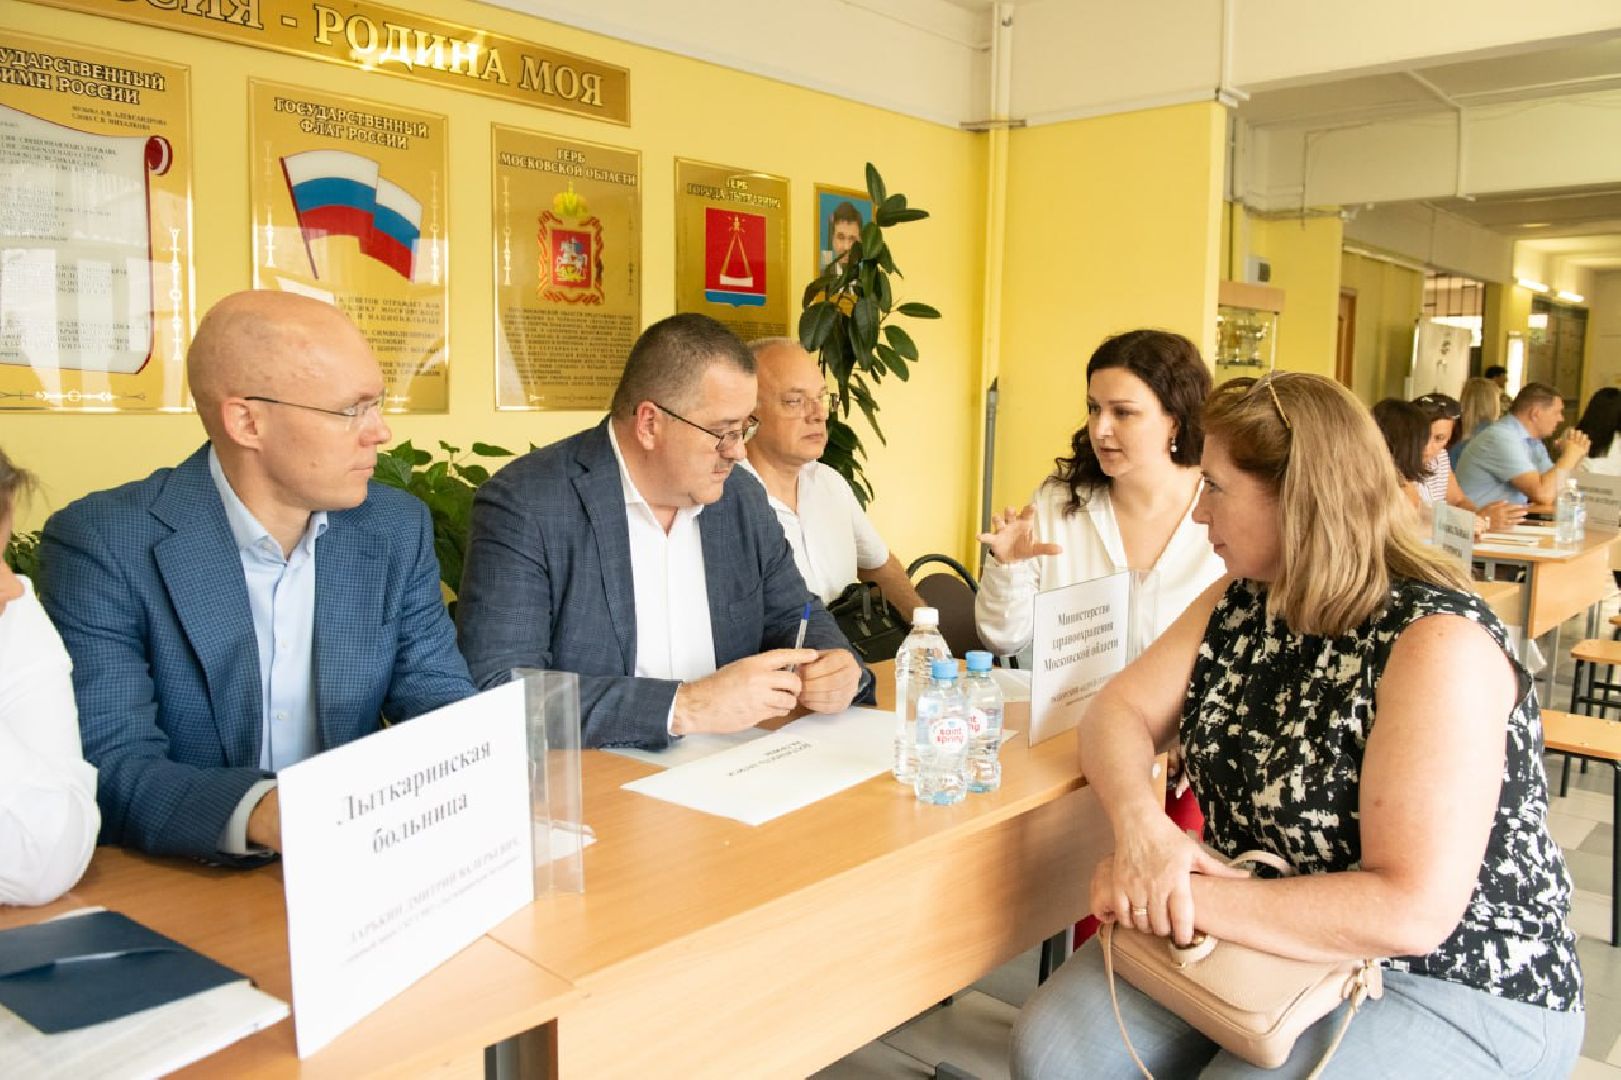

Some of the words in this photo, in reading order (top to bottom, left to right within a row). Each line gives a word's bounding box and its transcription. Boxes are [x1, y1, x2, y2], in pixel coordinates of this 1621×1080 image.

[313, 3, 510, 85] РОДИНА
[518, 54, 602, 107] МОЯ
[56, 76, 140, 105] РОССИИ
[274, 97, 430, 139] ГОСУДАРСТВЕННЫЙ
[300, 119, 344, 138] ФЛАГ
[348, 127, 409, 150] РОССИИ
[498, 151, 584, 178] МОСКОВСКОЙ
[585, 167, 638, 187] ОБЛАСТИ
[556, 148, 586, 164] ГЕРБ
[1058, 604, 1111, 626] Министерство
[1044, 645, 1090, 671] Московской
[1091, 639, 1119, 656] области
[936, 735, 964, 745] spring
[939, 727, 962, 736] saint
[336, 741, 491, 825] Лыткаринская
[373, 793, 468, 854] больница
